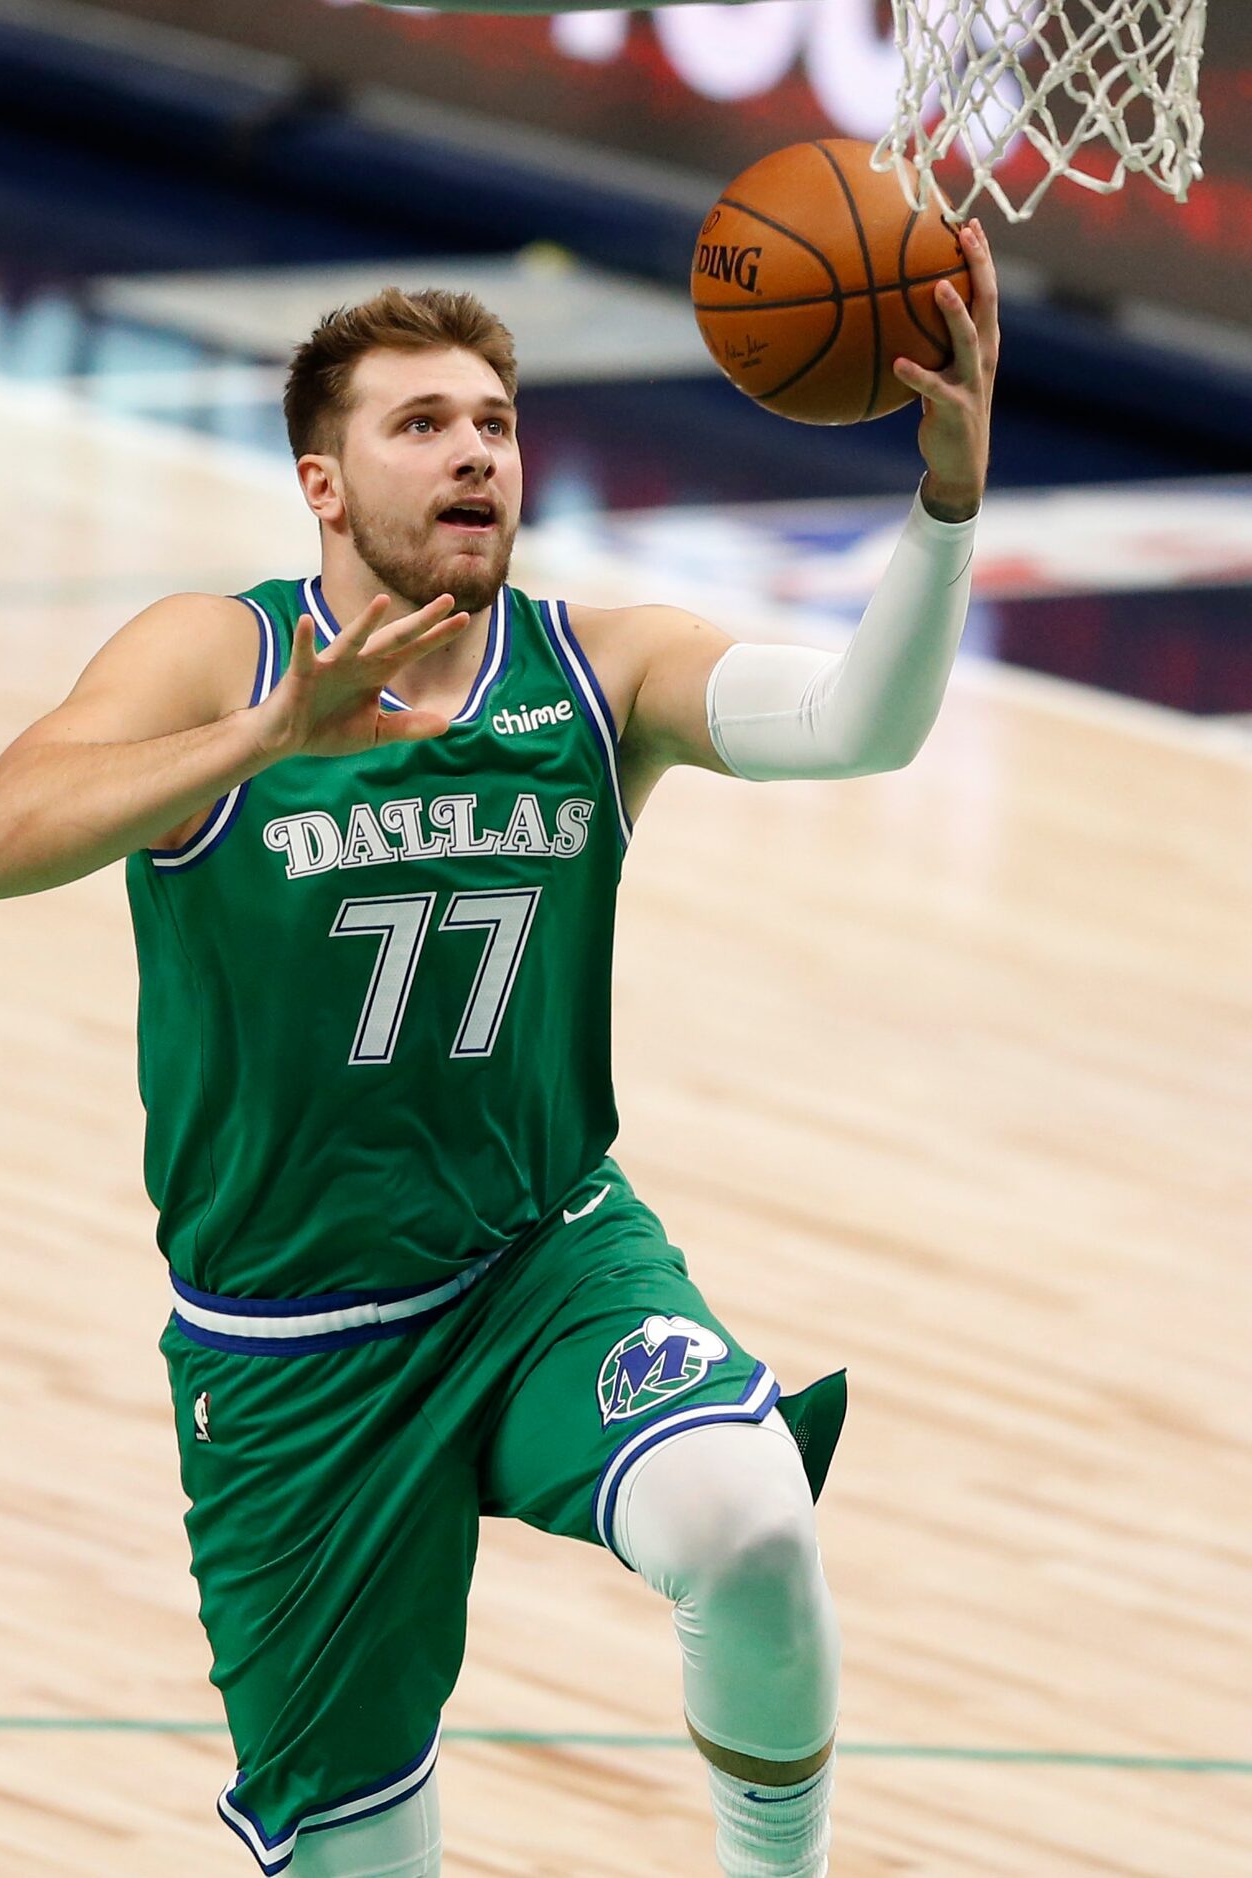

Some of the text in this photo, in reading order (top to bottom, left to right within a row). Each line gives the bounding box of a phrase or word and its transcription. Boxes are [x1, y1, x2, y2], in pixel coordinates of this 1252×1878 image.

[695, 245, 761, 293] DING
[492, 698, 573, 737] chime
[263, 793, 596, 880] DALLAS
[328, 886, 543, 1066] 77
